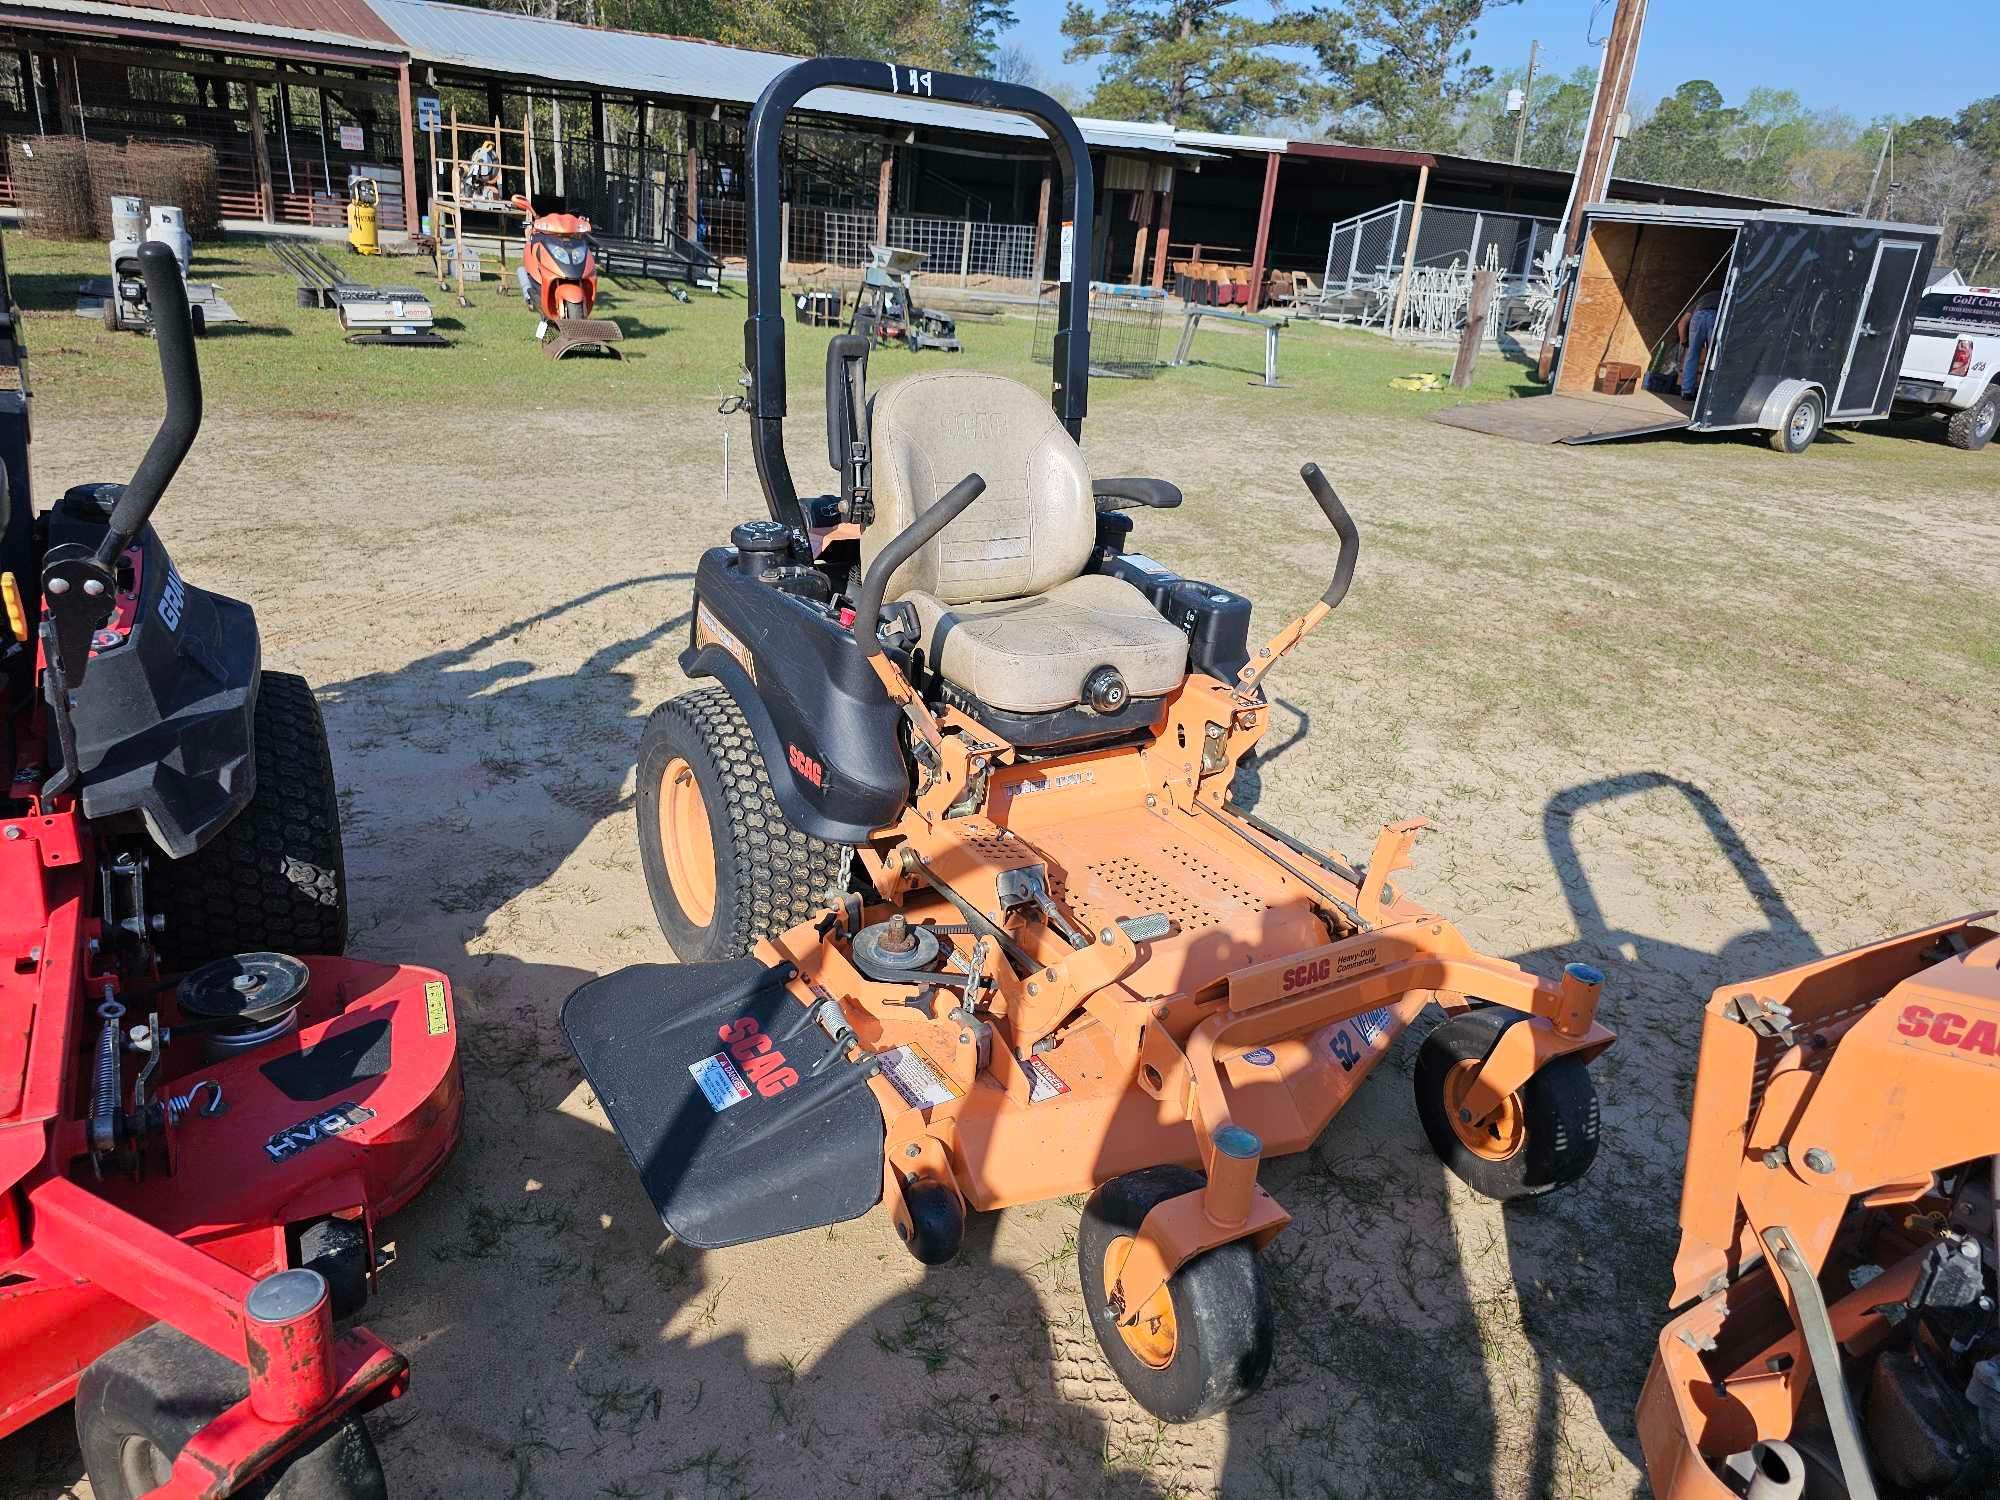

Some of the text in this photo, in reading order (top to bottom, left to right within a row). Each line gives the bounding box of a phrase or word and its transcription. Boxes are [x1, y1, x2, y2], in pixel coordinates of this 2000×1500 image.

[1953, 295, 1977, 305] Golf
[789, 744, 822, 789] SCAG
[1337, 954, 1377, 973] Commercial
[1338, 947, 1376, 964] Heavy-Duty
[1283, 958, 1330, 991] SCAG
[719, 1017, 799, 1100] SCAG
[1329, 1029, 1361, 1072] 52
[724, 1065, 747, 1093] DANGER
